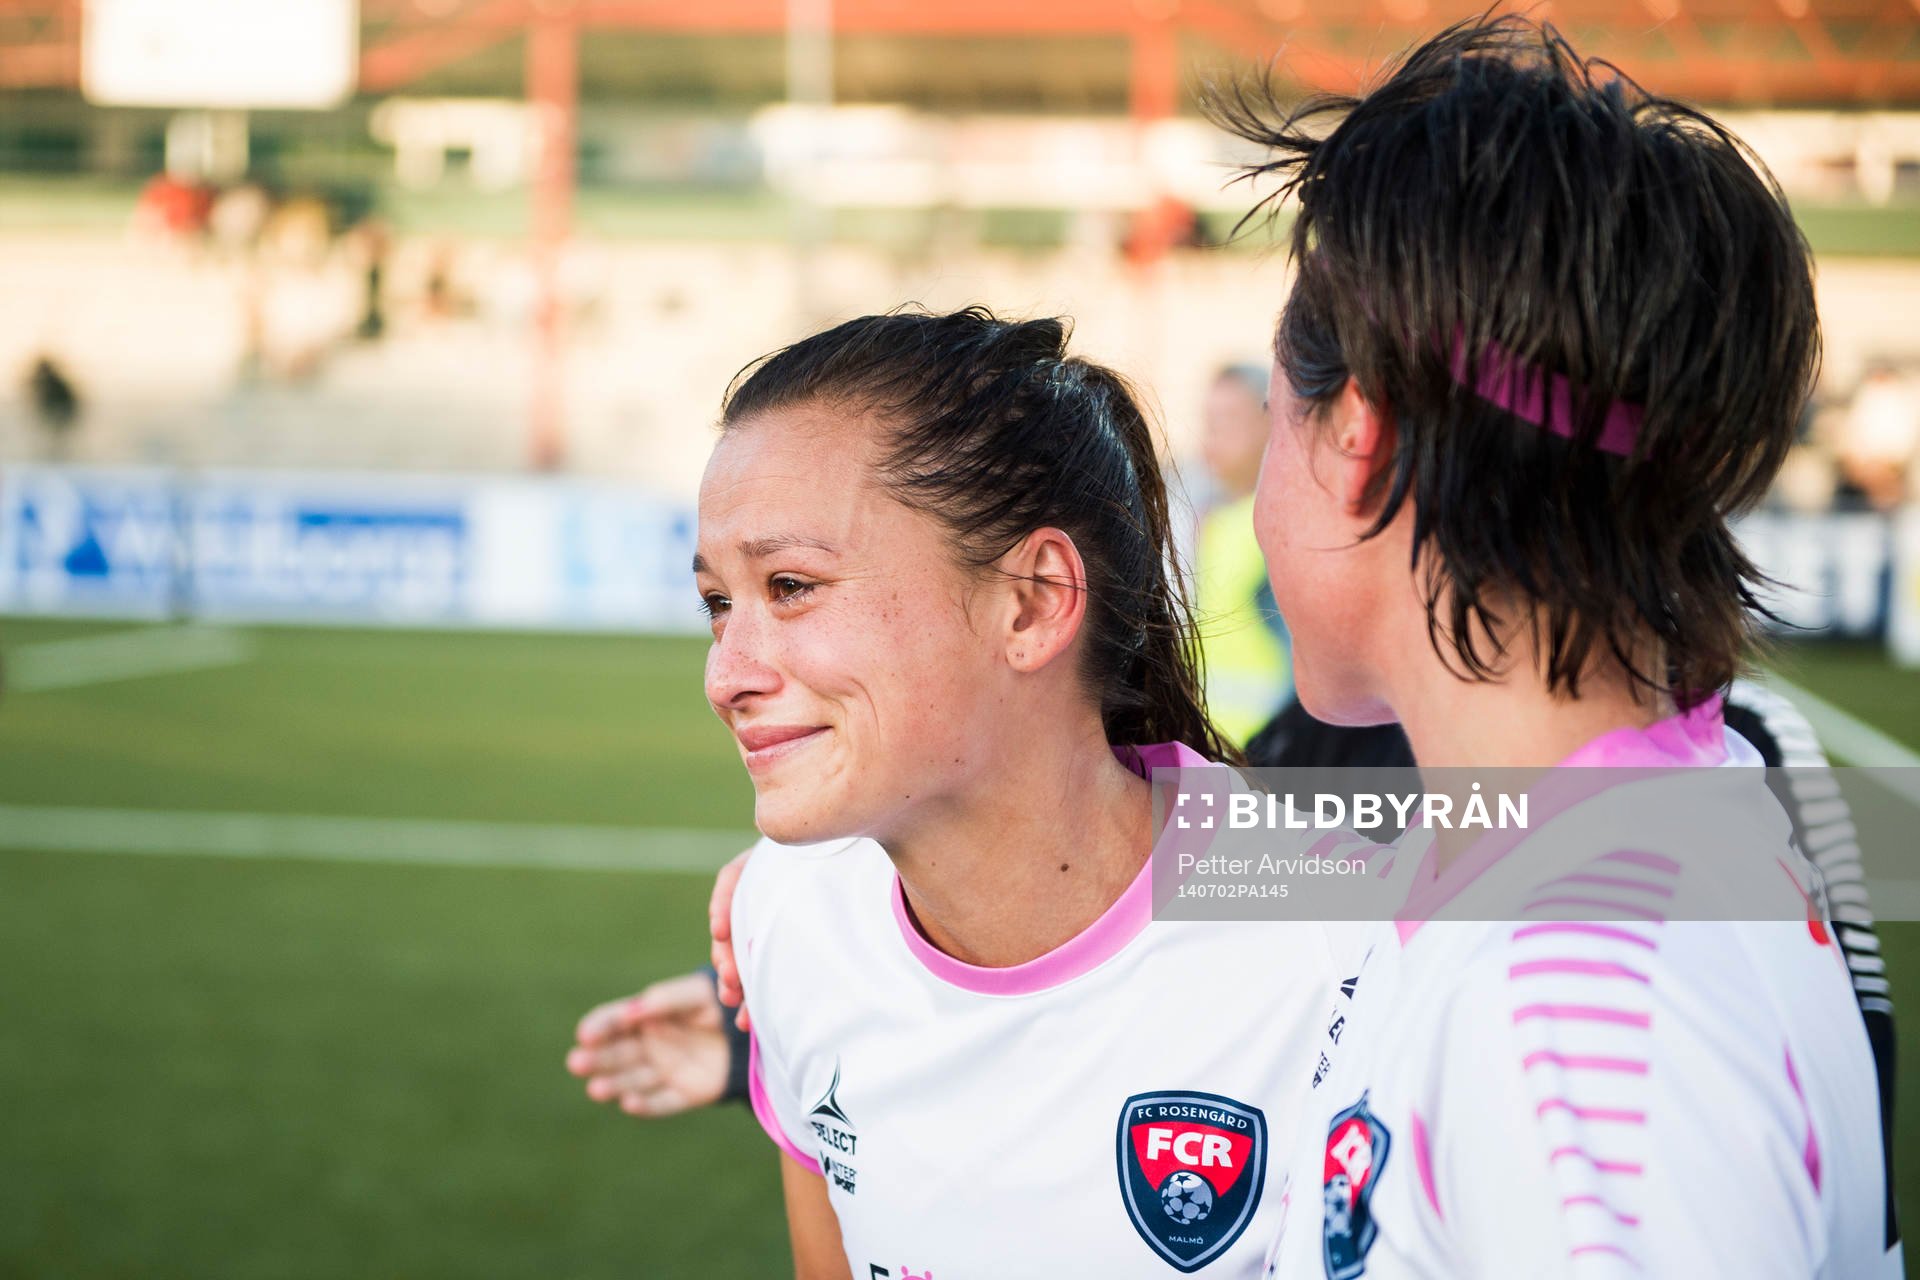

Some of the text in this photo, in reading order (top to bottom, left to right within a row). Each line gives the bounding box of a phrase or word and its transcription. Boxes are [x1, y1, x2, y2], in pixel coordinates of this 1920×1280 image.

[1137, 1105, 1248, 1130] FC ROSENGÅRD
[1146, 1127, 1233, 1168] FCR
[1168, 1234, 1204, 1245] MALMÖ
